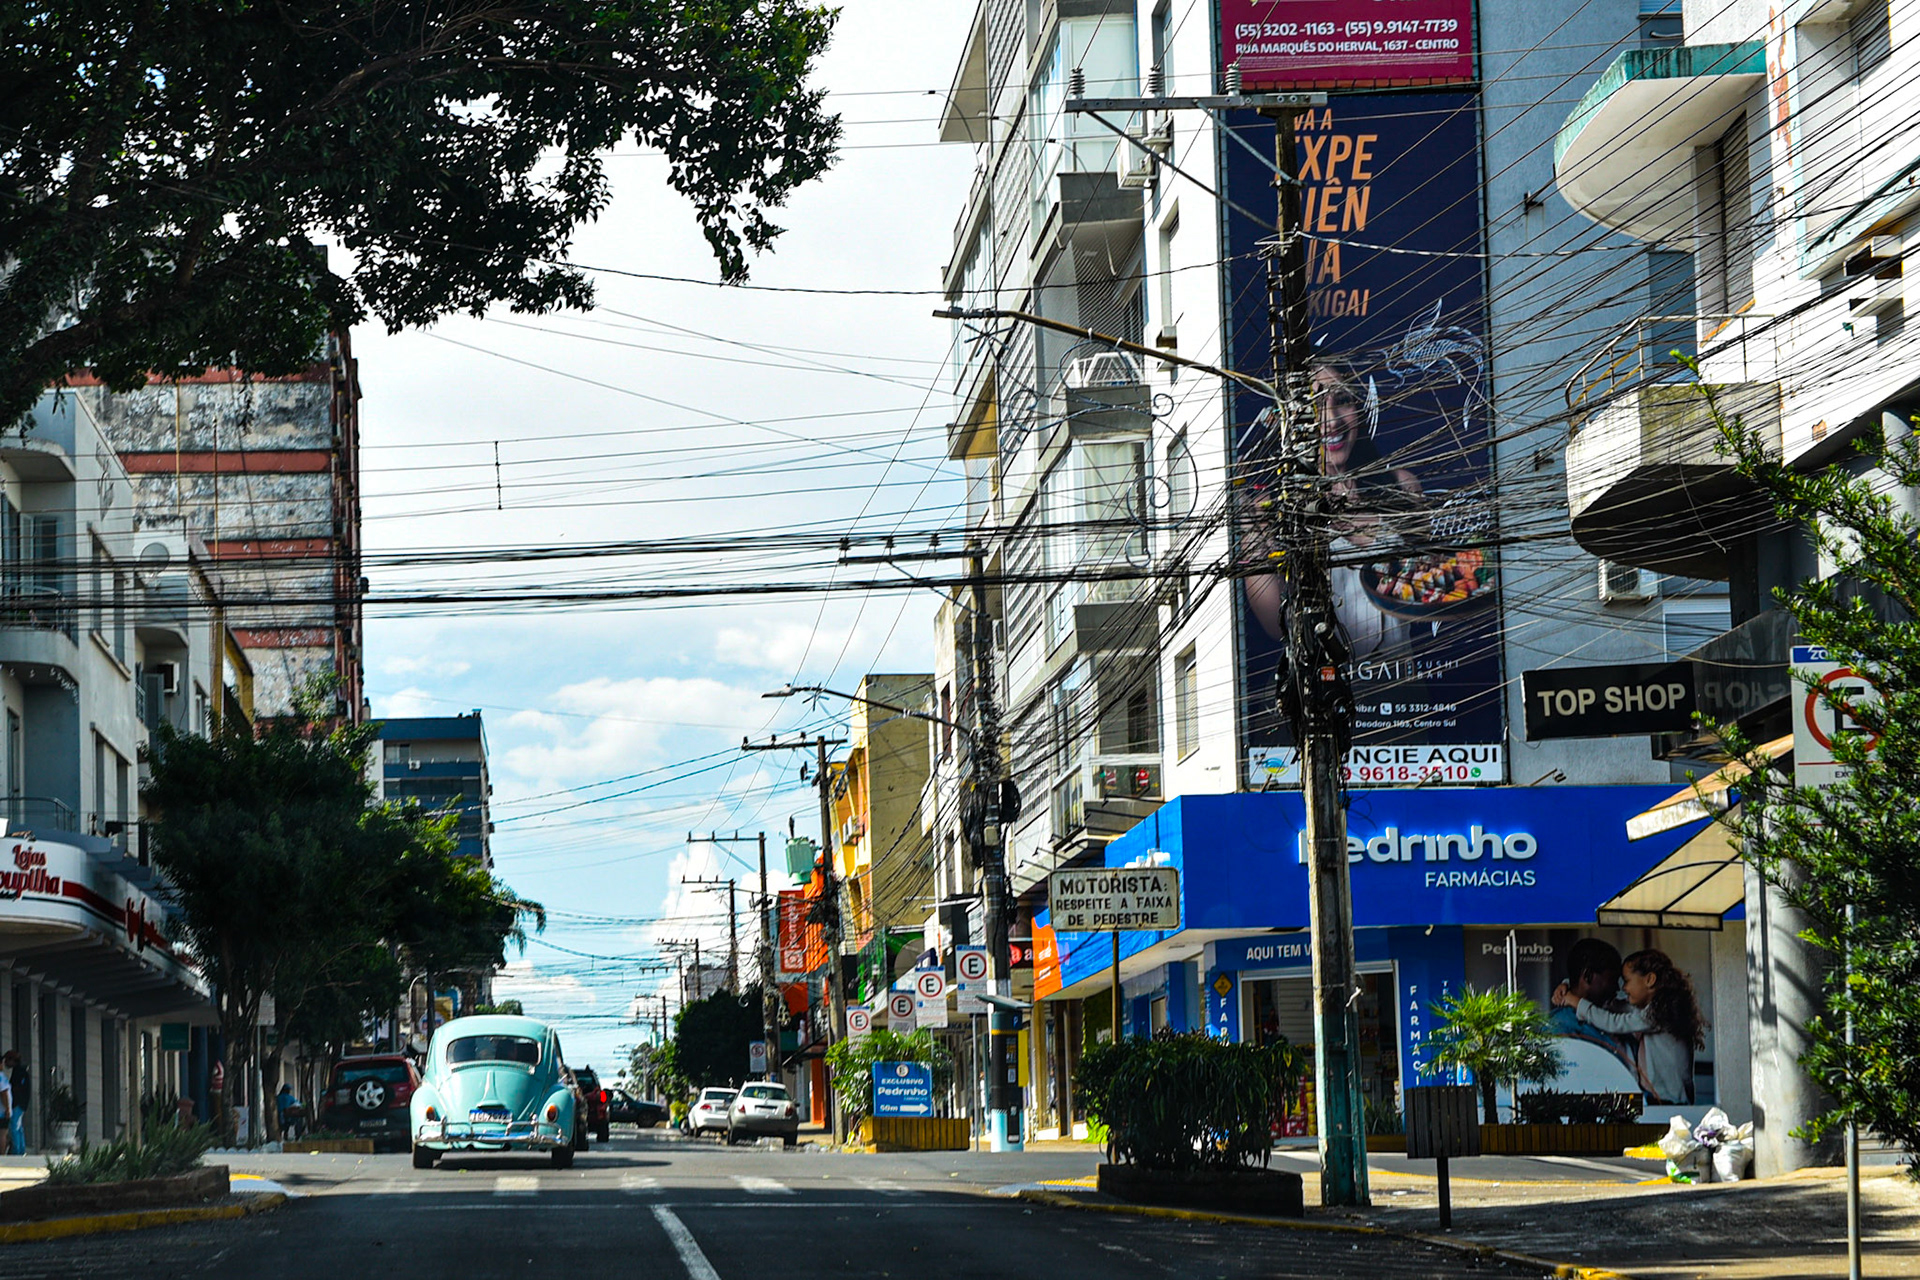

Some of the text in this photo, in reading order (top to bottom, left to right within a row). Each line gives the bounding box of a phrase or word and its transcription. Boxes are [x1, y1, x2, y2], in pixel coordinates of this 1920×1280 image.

[1235, 23, 1261, 39] (55)
[1345, 21, 1372, 37] (55)
[1374, 19, 1458, 34] 9.9147-7739
[1236, 42, 1259, 54] RUA
[1260, 40, 1316, 54] MARQUÊS
[1317, 41, 1334, 52] DO
[1336, 40, 1382, 53] HERVAL,
[1384, 40, 1408, 50] 1637
[1415, 38, 1459, 50] CENTRO
[1320, 108, 1333, 130] A
[1294, 134, 1378, 181] XPE
[1302, 177, 1371, 232] IÊN
[1537, 682, 1687, 717] TOP SHOP
[1427, 747, 1498, 764] AQUI
[1359, 764, 1469, 781] 9618-3510
[1297, 824, 1538, 863] edrinho
[1425, 868, 1536, 887] FARMÁCIAS
[1056, 896, 1173, 911] RESPEITE A FAIXA
[1068, 912, 1159, 926] DE PEDESTRE
[1246, 946, 1274, 961] AQUI
[1277, 944, 1301, 957] TEM
[968, 957, 979, 975] E
[925, 978, 935, 993] E
[897, 1000, 906, 1013] E
[855, 1015, 863, 1027] E
[877, 1086, 928, 1096] Pedrinho
